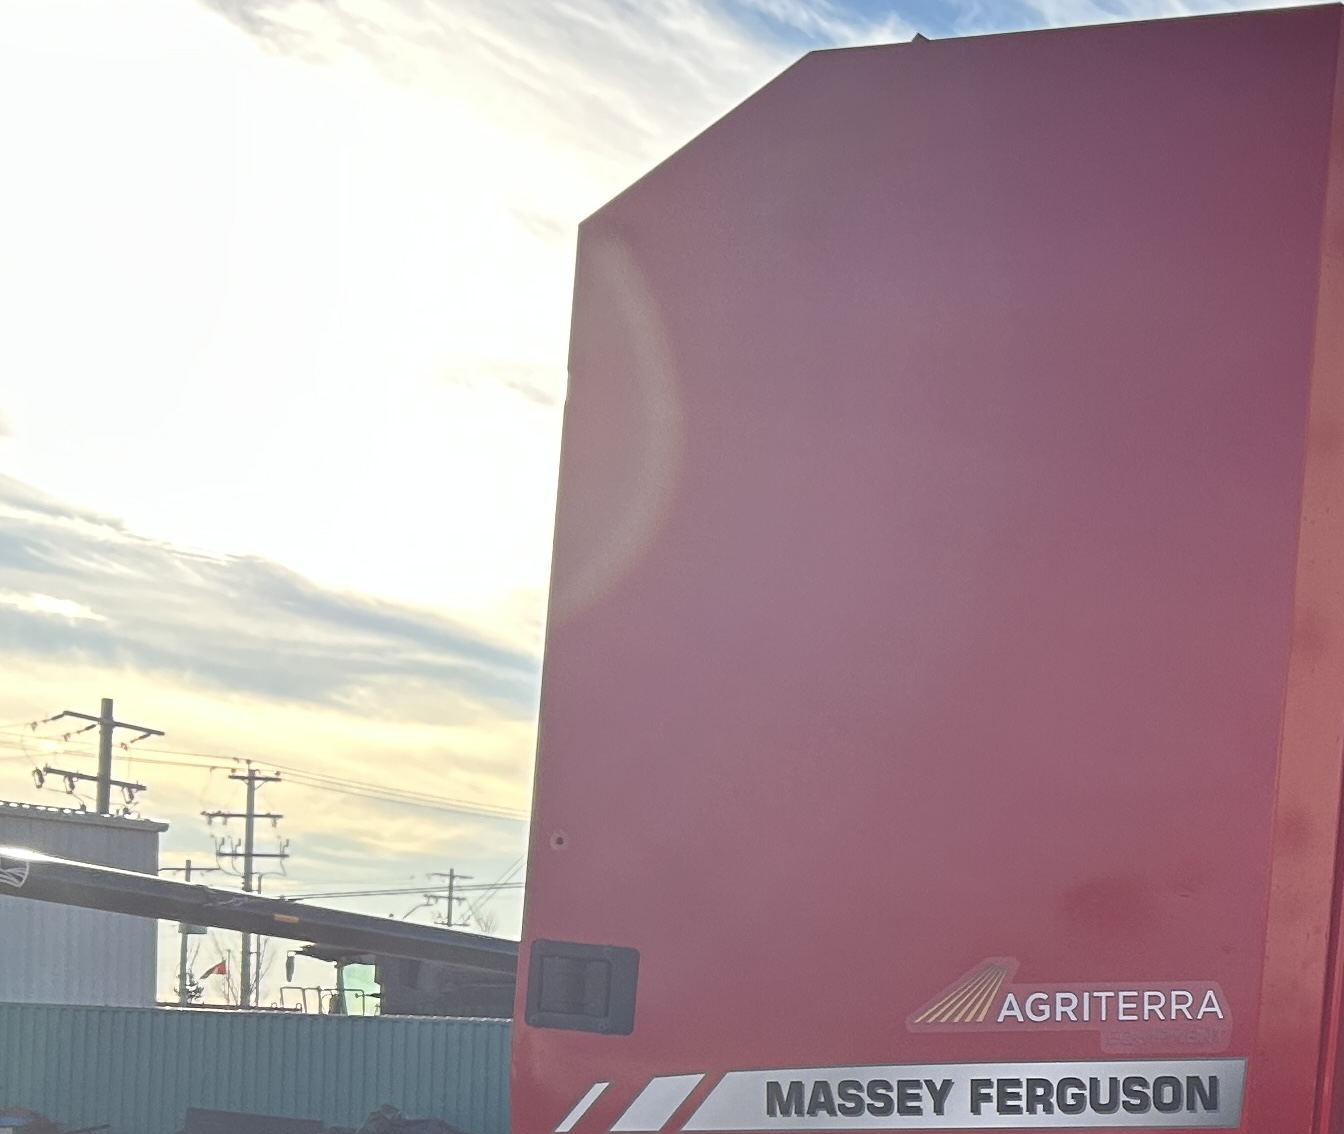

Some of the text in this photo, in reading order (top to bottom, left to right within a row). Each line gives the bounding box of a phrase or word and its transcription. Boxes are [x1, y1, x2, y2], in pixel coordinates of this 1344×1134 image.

[997, 989, 1225, 1022] AGRITERRA
[766, 1075, 1220, 1117] MASSEY FERGUSON
